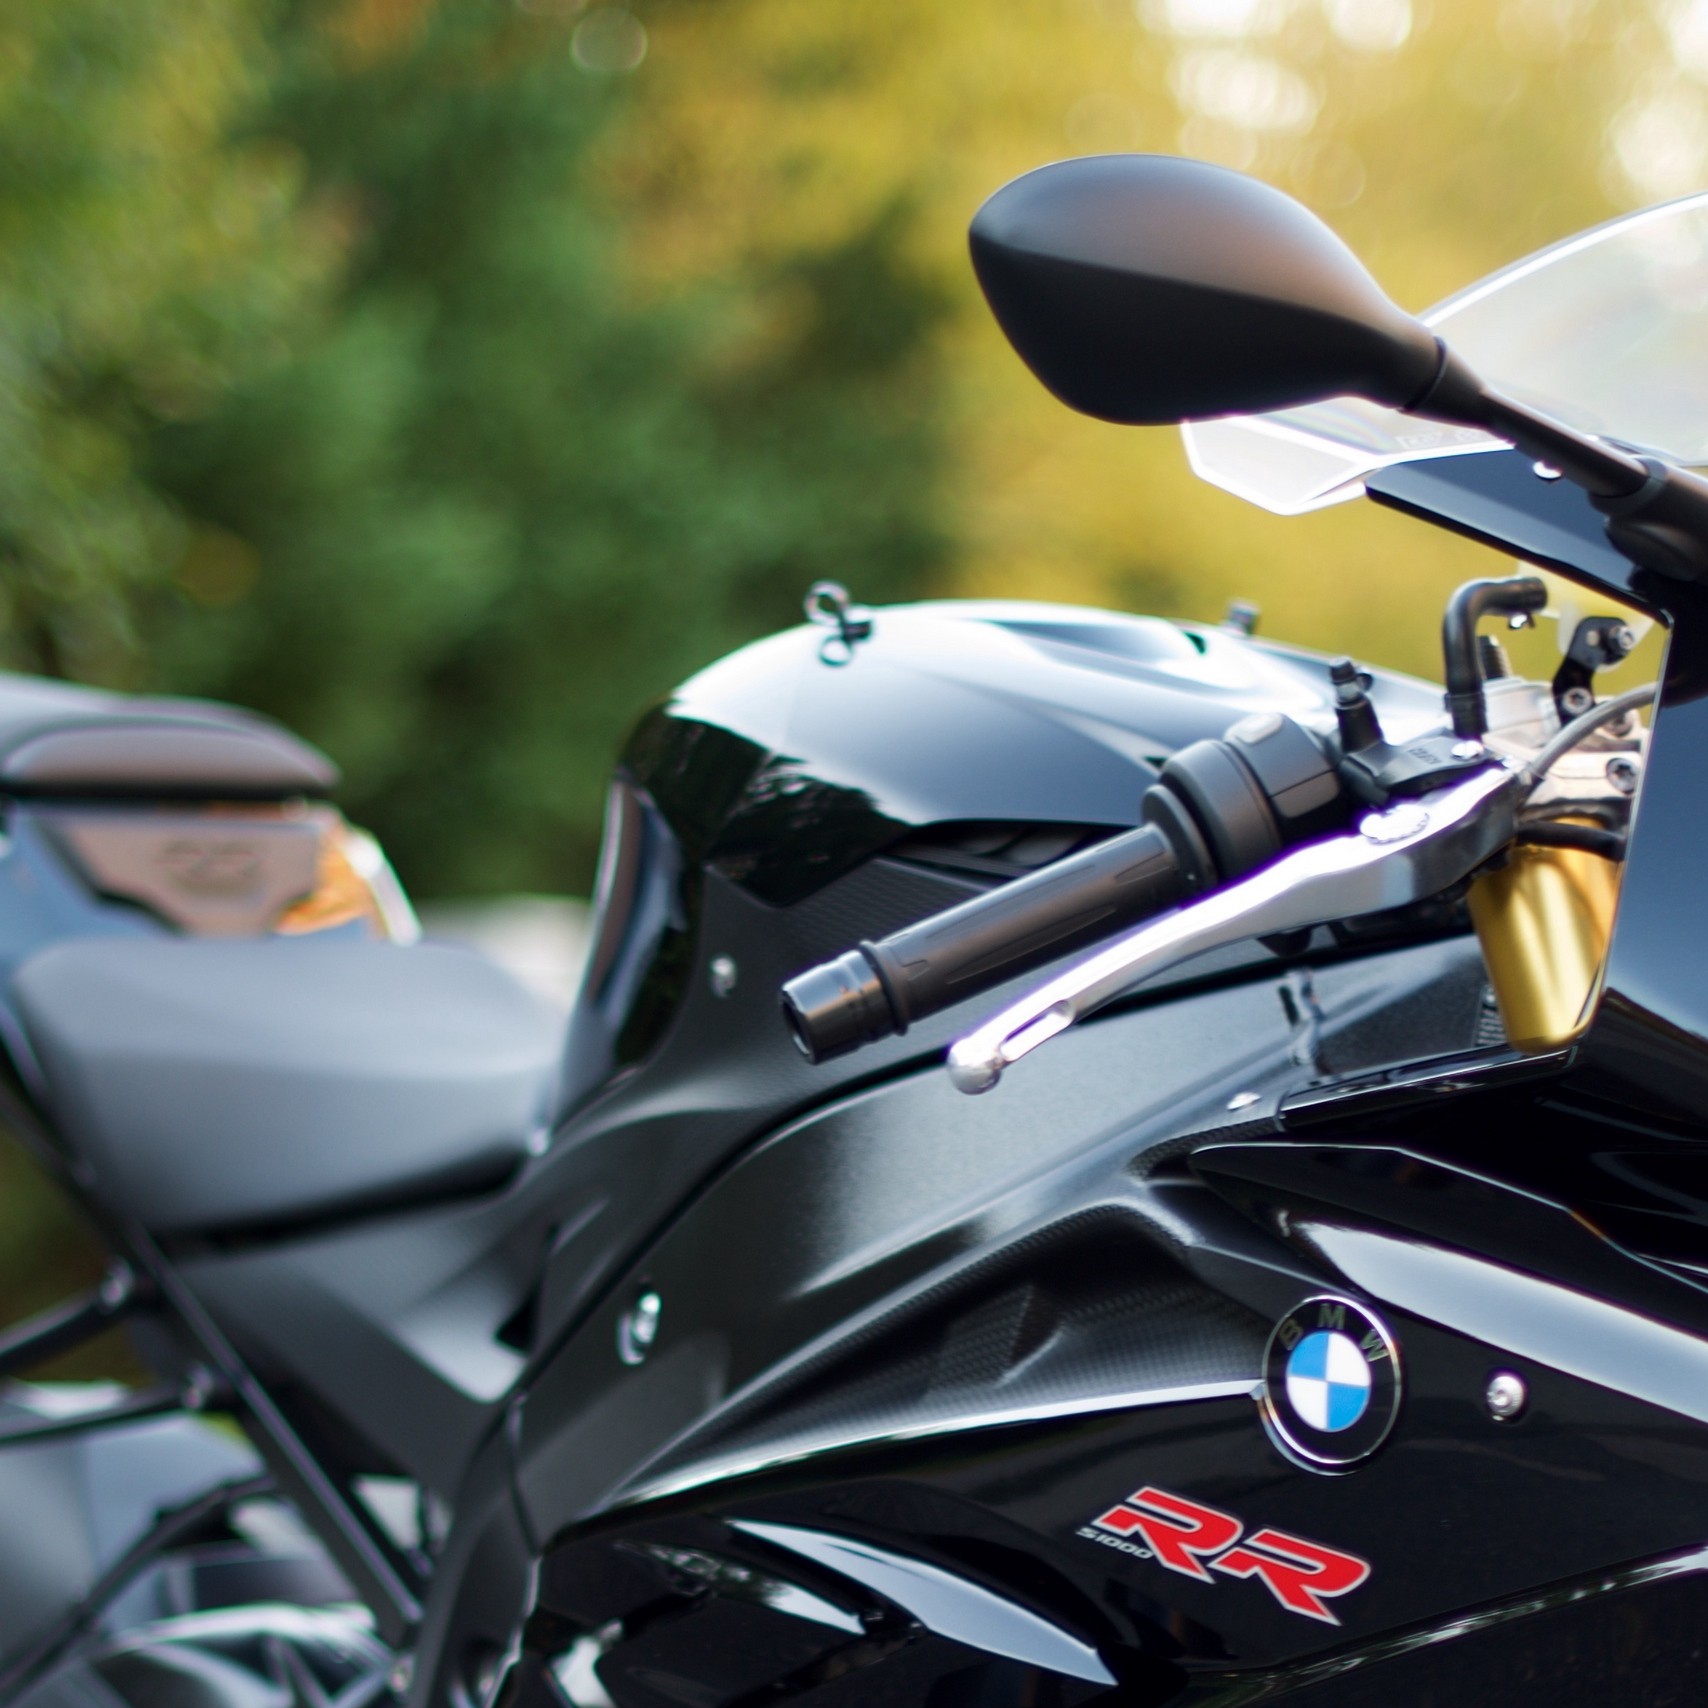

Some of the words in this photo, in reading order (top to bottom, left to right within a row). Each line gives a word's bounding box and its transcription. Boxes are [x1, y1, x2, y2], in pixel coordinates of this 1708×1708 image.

[1277, 1302, 1390, 1362] BMW
[1075, 1526, 1155, 1560] S1000
[1091, 1486, 1371, 1627] RR
